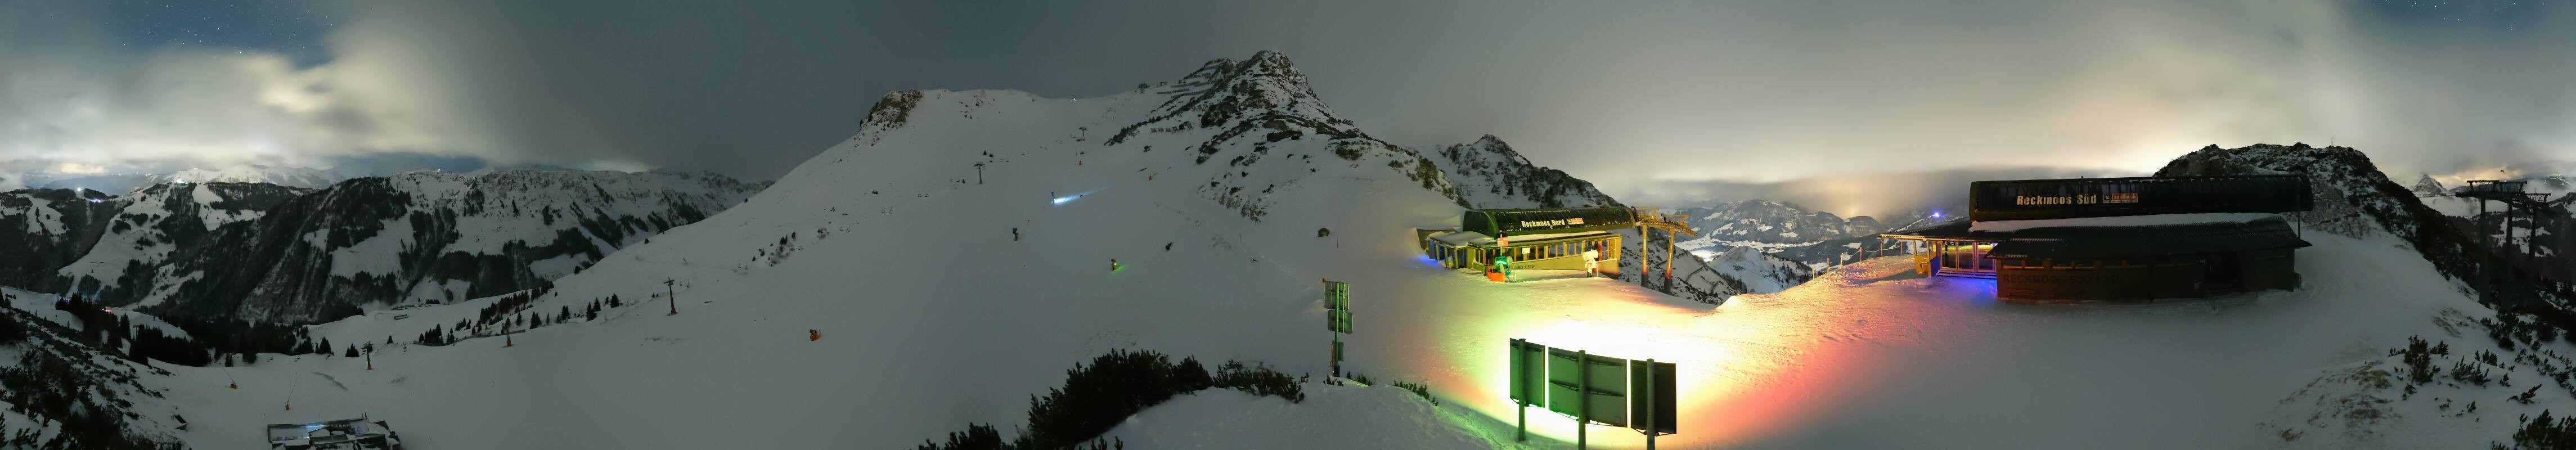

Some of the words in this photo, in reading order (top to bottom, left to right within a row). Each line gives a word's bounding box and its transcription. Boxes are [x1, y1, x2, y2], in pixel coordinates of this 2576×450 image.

[2017, 195, 2072, 205] Reckmoos
[2076, 194, 2097, 205] Süd
[2003, 274, 2066, 284] RECKMOOS
